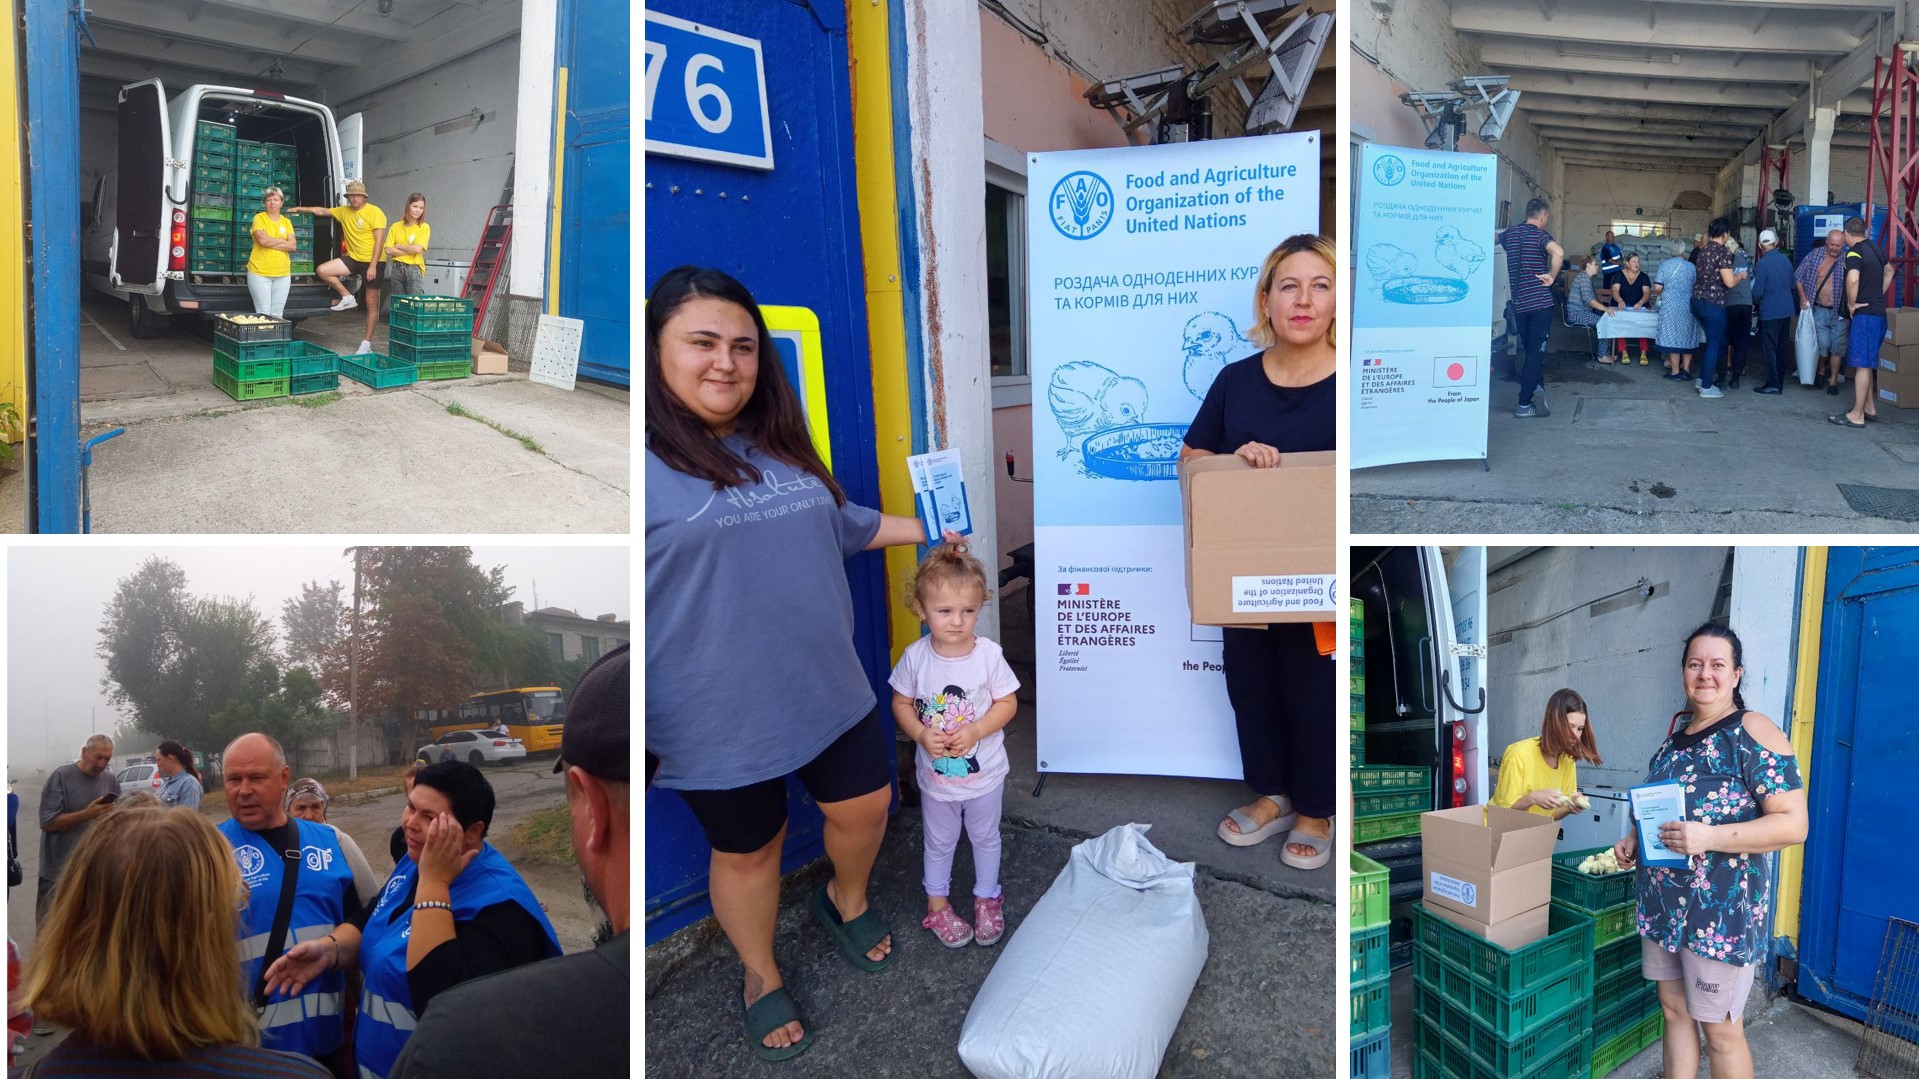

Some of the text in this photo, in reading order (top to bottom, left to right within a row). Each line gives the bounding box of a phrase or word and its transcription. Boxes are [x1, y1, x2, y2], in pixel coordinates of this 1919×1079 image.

[1412, 160, 1487, 172] Food and Agriculture
[1126, 164, 1297, 189] Food and Agriculture
[1411, 170, 1458, 180] Organization
[1411, 180, 1466, 190] United Nations
[1126, 186, 1284, 214] Organization of the
[1373, 202, 1406, 210] РОЗДАЧА
[1408, 204, 1457, 213] ОДНОДЕННИХ
[1057, 216, 1078, 234] FIAT
[1086, 210, 1108, 234] PANIS
[1126, 212, 1246, 234] United Nations
[1054, 266, 1262, 291] РОЗДАЧА ОДНОДЕННИХ КУР
[1054, 291, 1198, 310] ТА КОРМІВ ДЛЯ НИХ
[716, 514, 741, 528] YOU
[744, 511, 762, 522] ARE
[762, 505, 789, 519] YOUR
[790, 498, 816, 513] ONLY
[1068, 565, 1110, 574] фінансової
[1296, 578, 1323, 586] United
[1270, 586, 1323, 597] Organization
[1057, 598, 1121, 609] MINISTÈRE
[1238, 598, 1323, 607] Food and Agriculture
[1057, 612, 1131, 622] DE L'EUROPE
[1057, 624, 1155, 634] ET DES AFFAIRES
[1057, 634, 1136, 646] ÉTRANGÈRES
[1182, 660, 1199, 671] the
